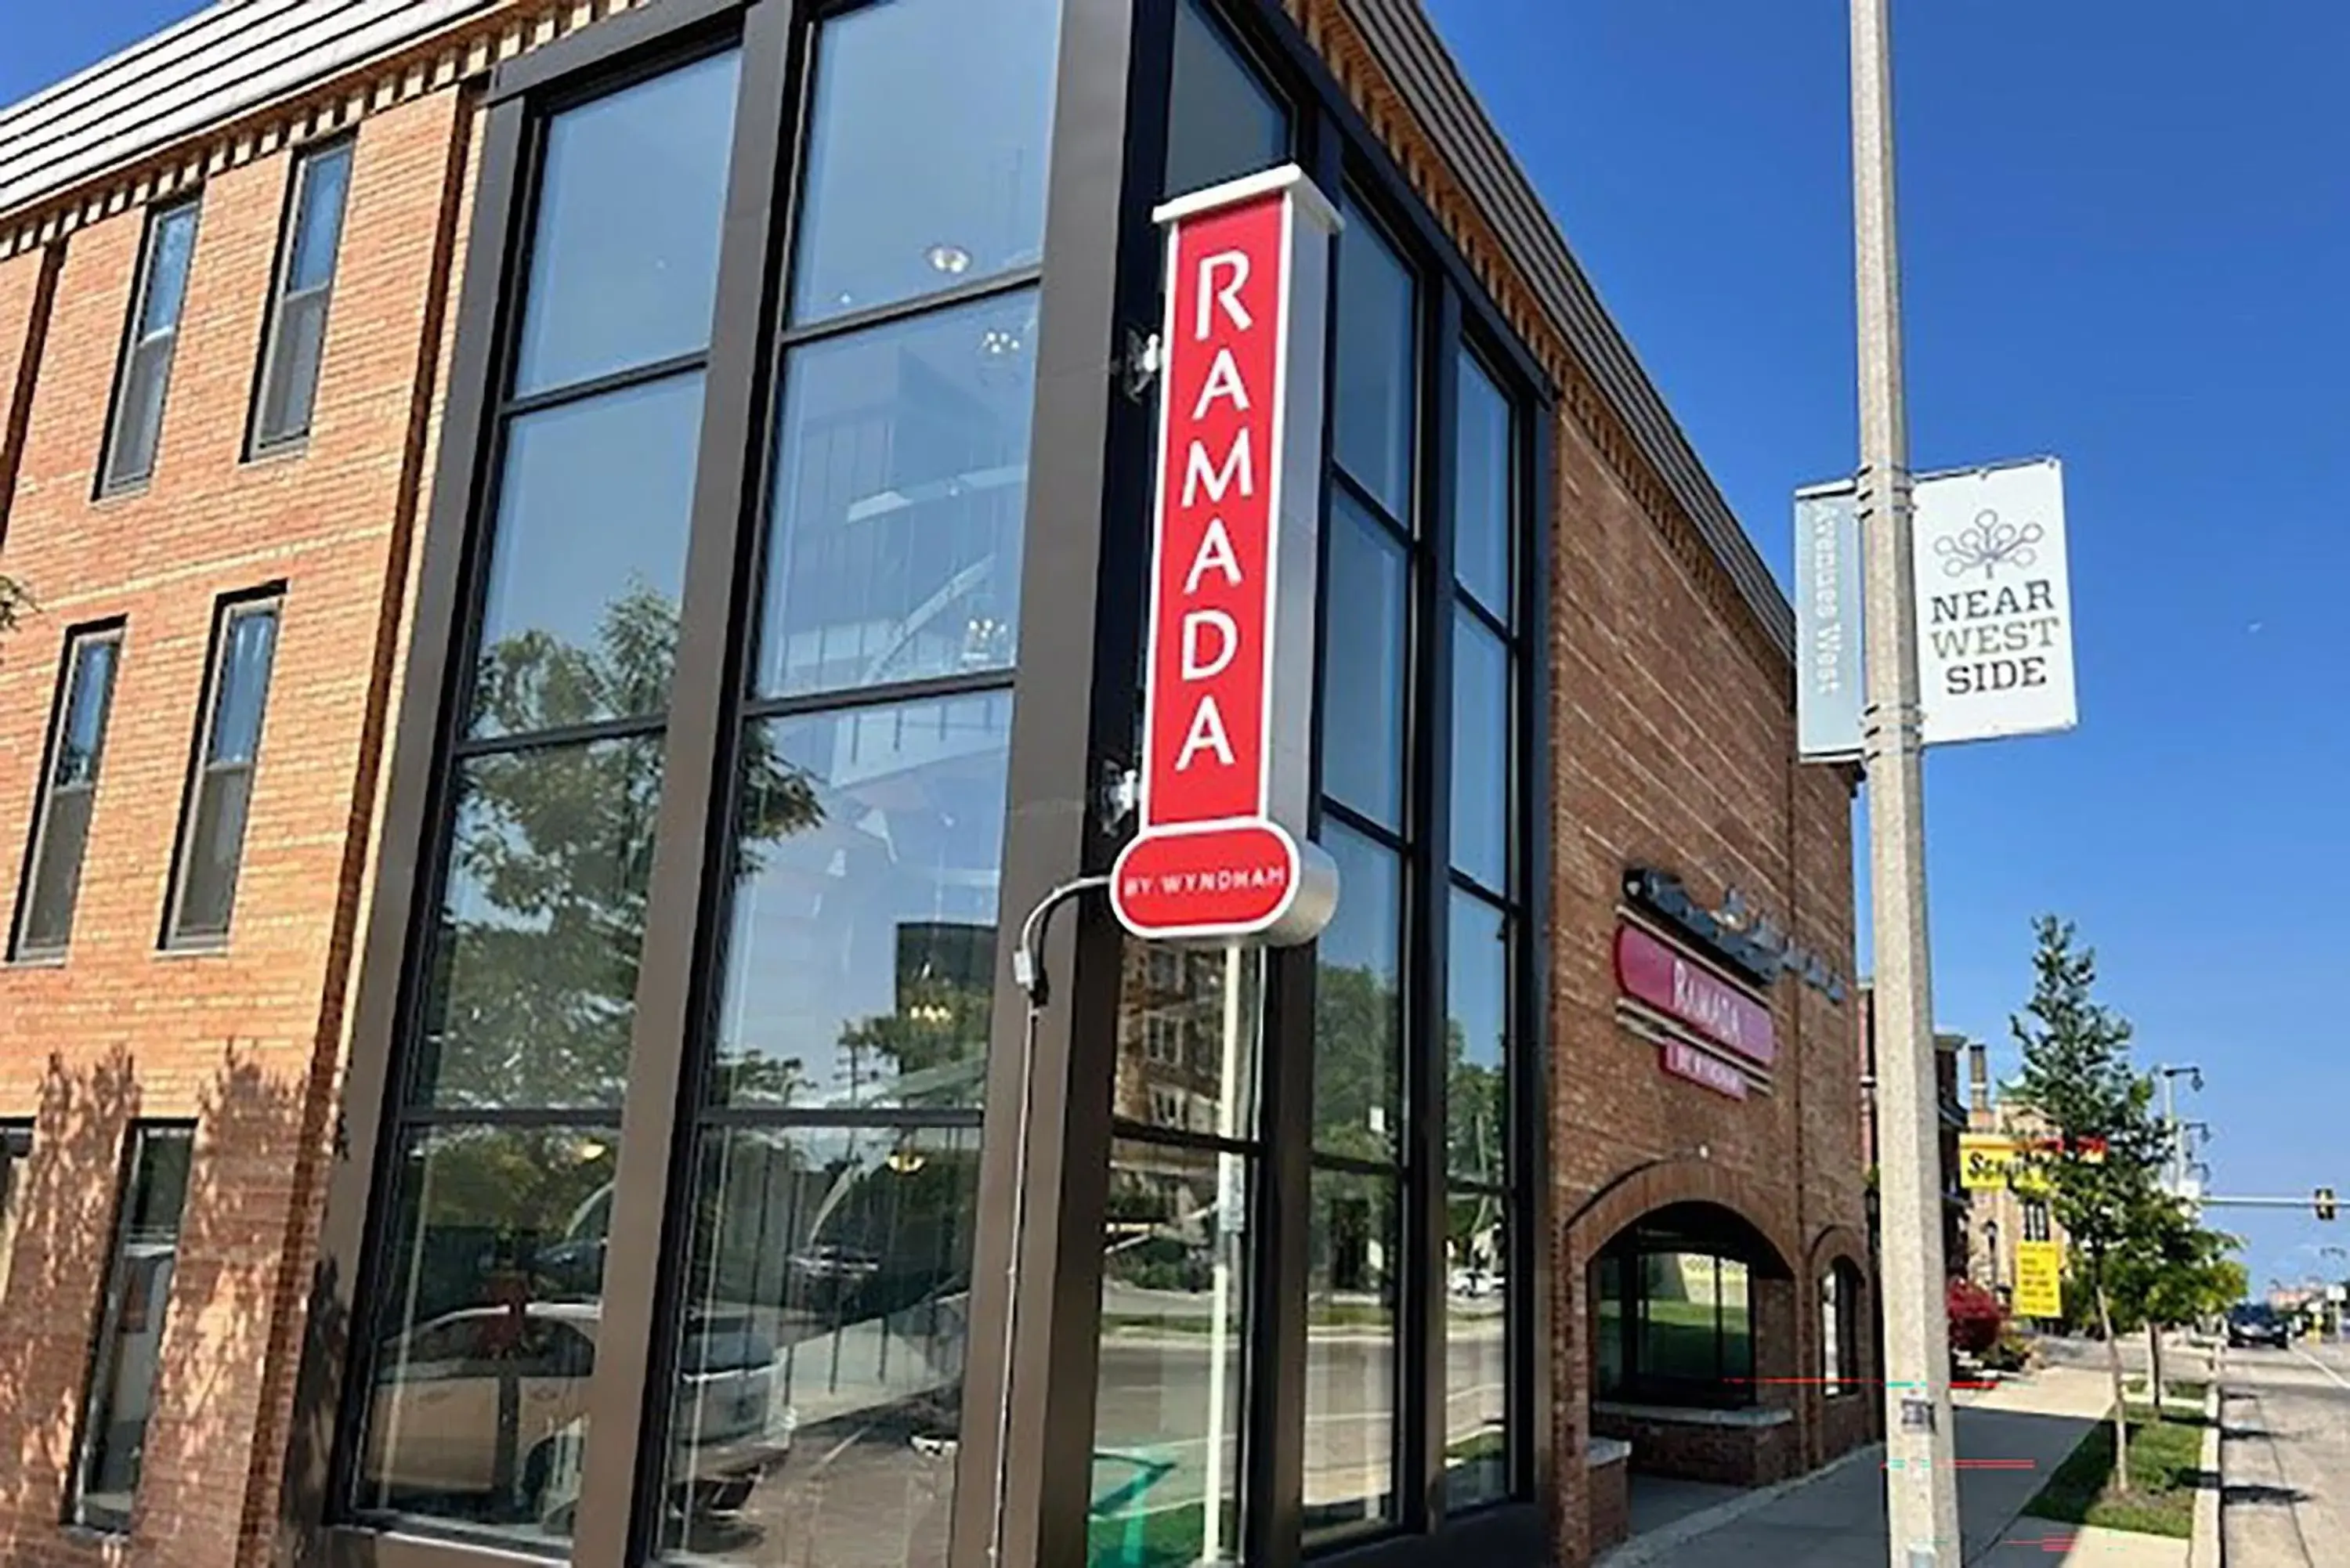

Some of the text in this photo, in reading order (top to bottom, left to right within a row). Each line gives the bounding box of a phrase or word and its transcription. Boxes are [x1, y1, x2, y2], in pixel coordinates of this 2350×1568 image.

[1175, 249, 1253, 771] RAMADA
[1929, 579, 2055, 624] NEAR
[1815, 623, 1841, 695] West
[1930, 616, 2060, 660] WEST
[1945, 656, 2047, 695] SIDE
[1123, 865, 1285, 897] BY WYNDHAM
